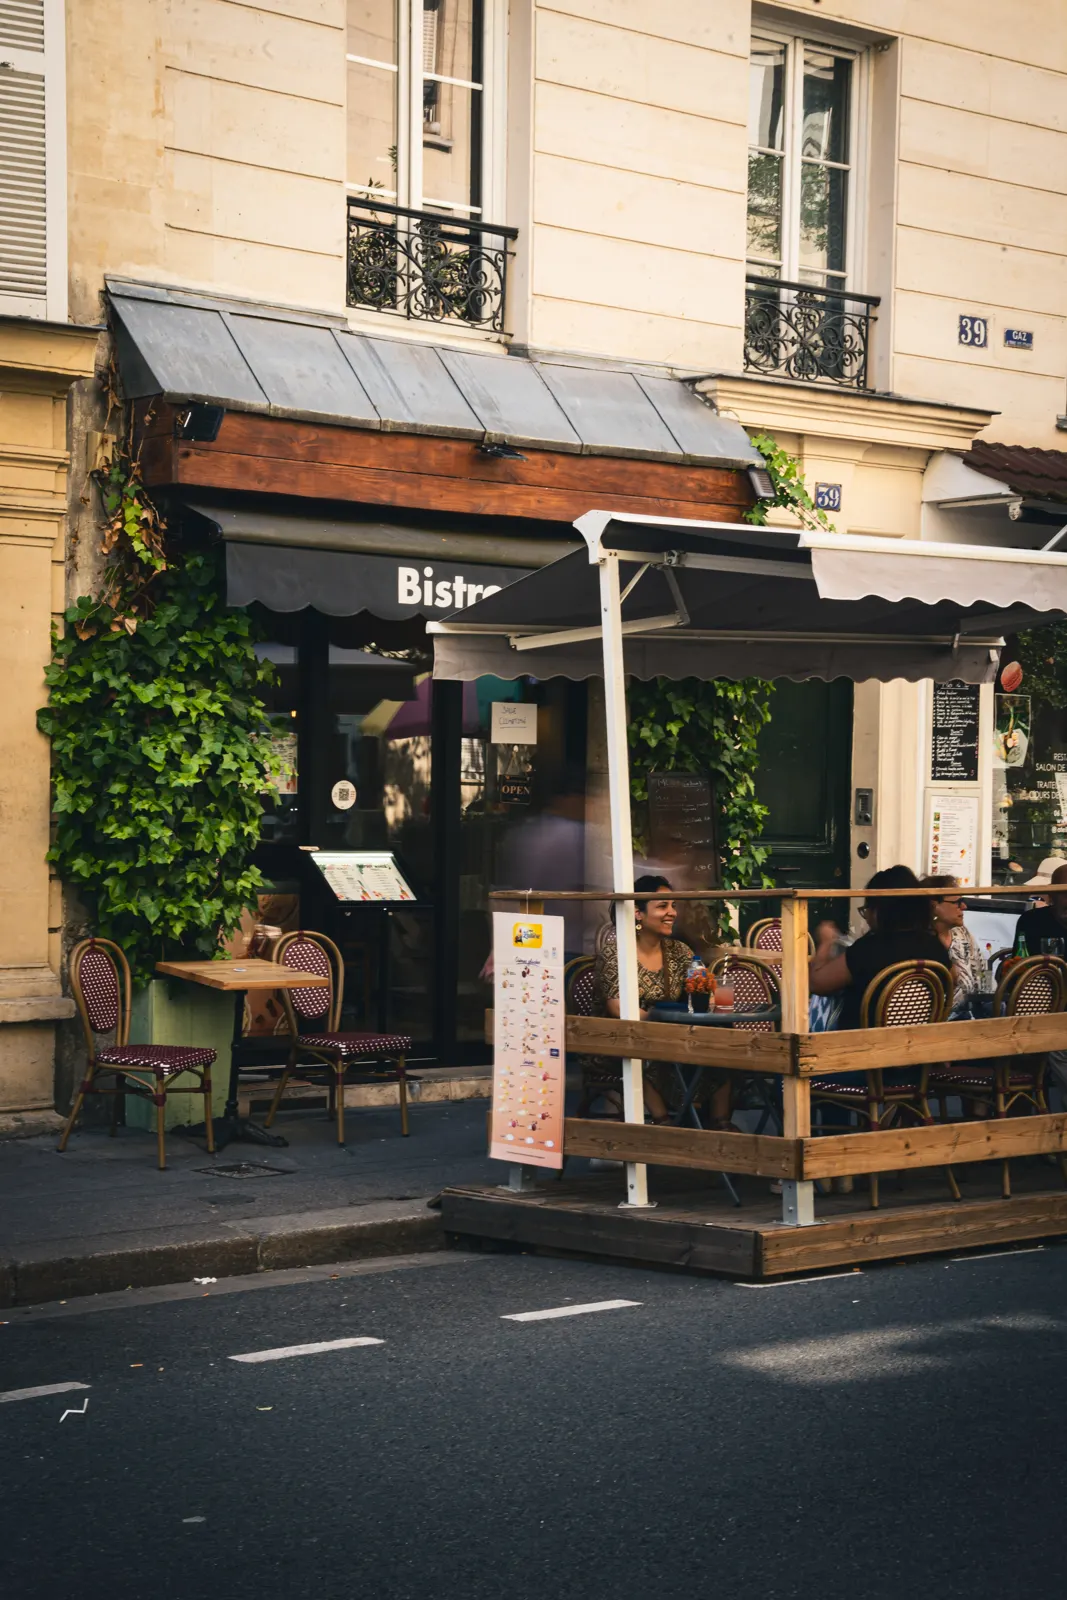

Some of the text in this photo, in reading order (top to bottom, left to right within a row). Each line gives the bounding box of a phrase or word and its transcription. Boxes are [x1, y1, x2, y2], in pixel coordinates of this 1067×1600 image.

[961, 318, 986, 346] 39
[1012, 330, 1027, 342] GAZ
[817, 485, 840, 508] 39
[1035, 762, 1066, 771] SALON DE
[502, 784, 531, 795] OPEN
[1037, 781, 1057, 789] TRAITE
